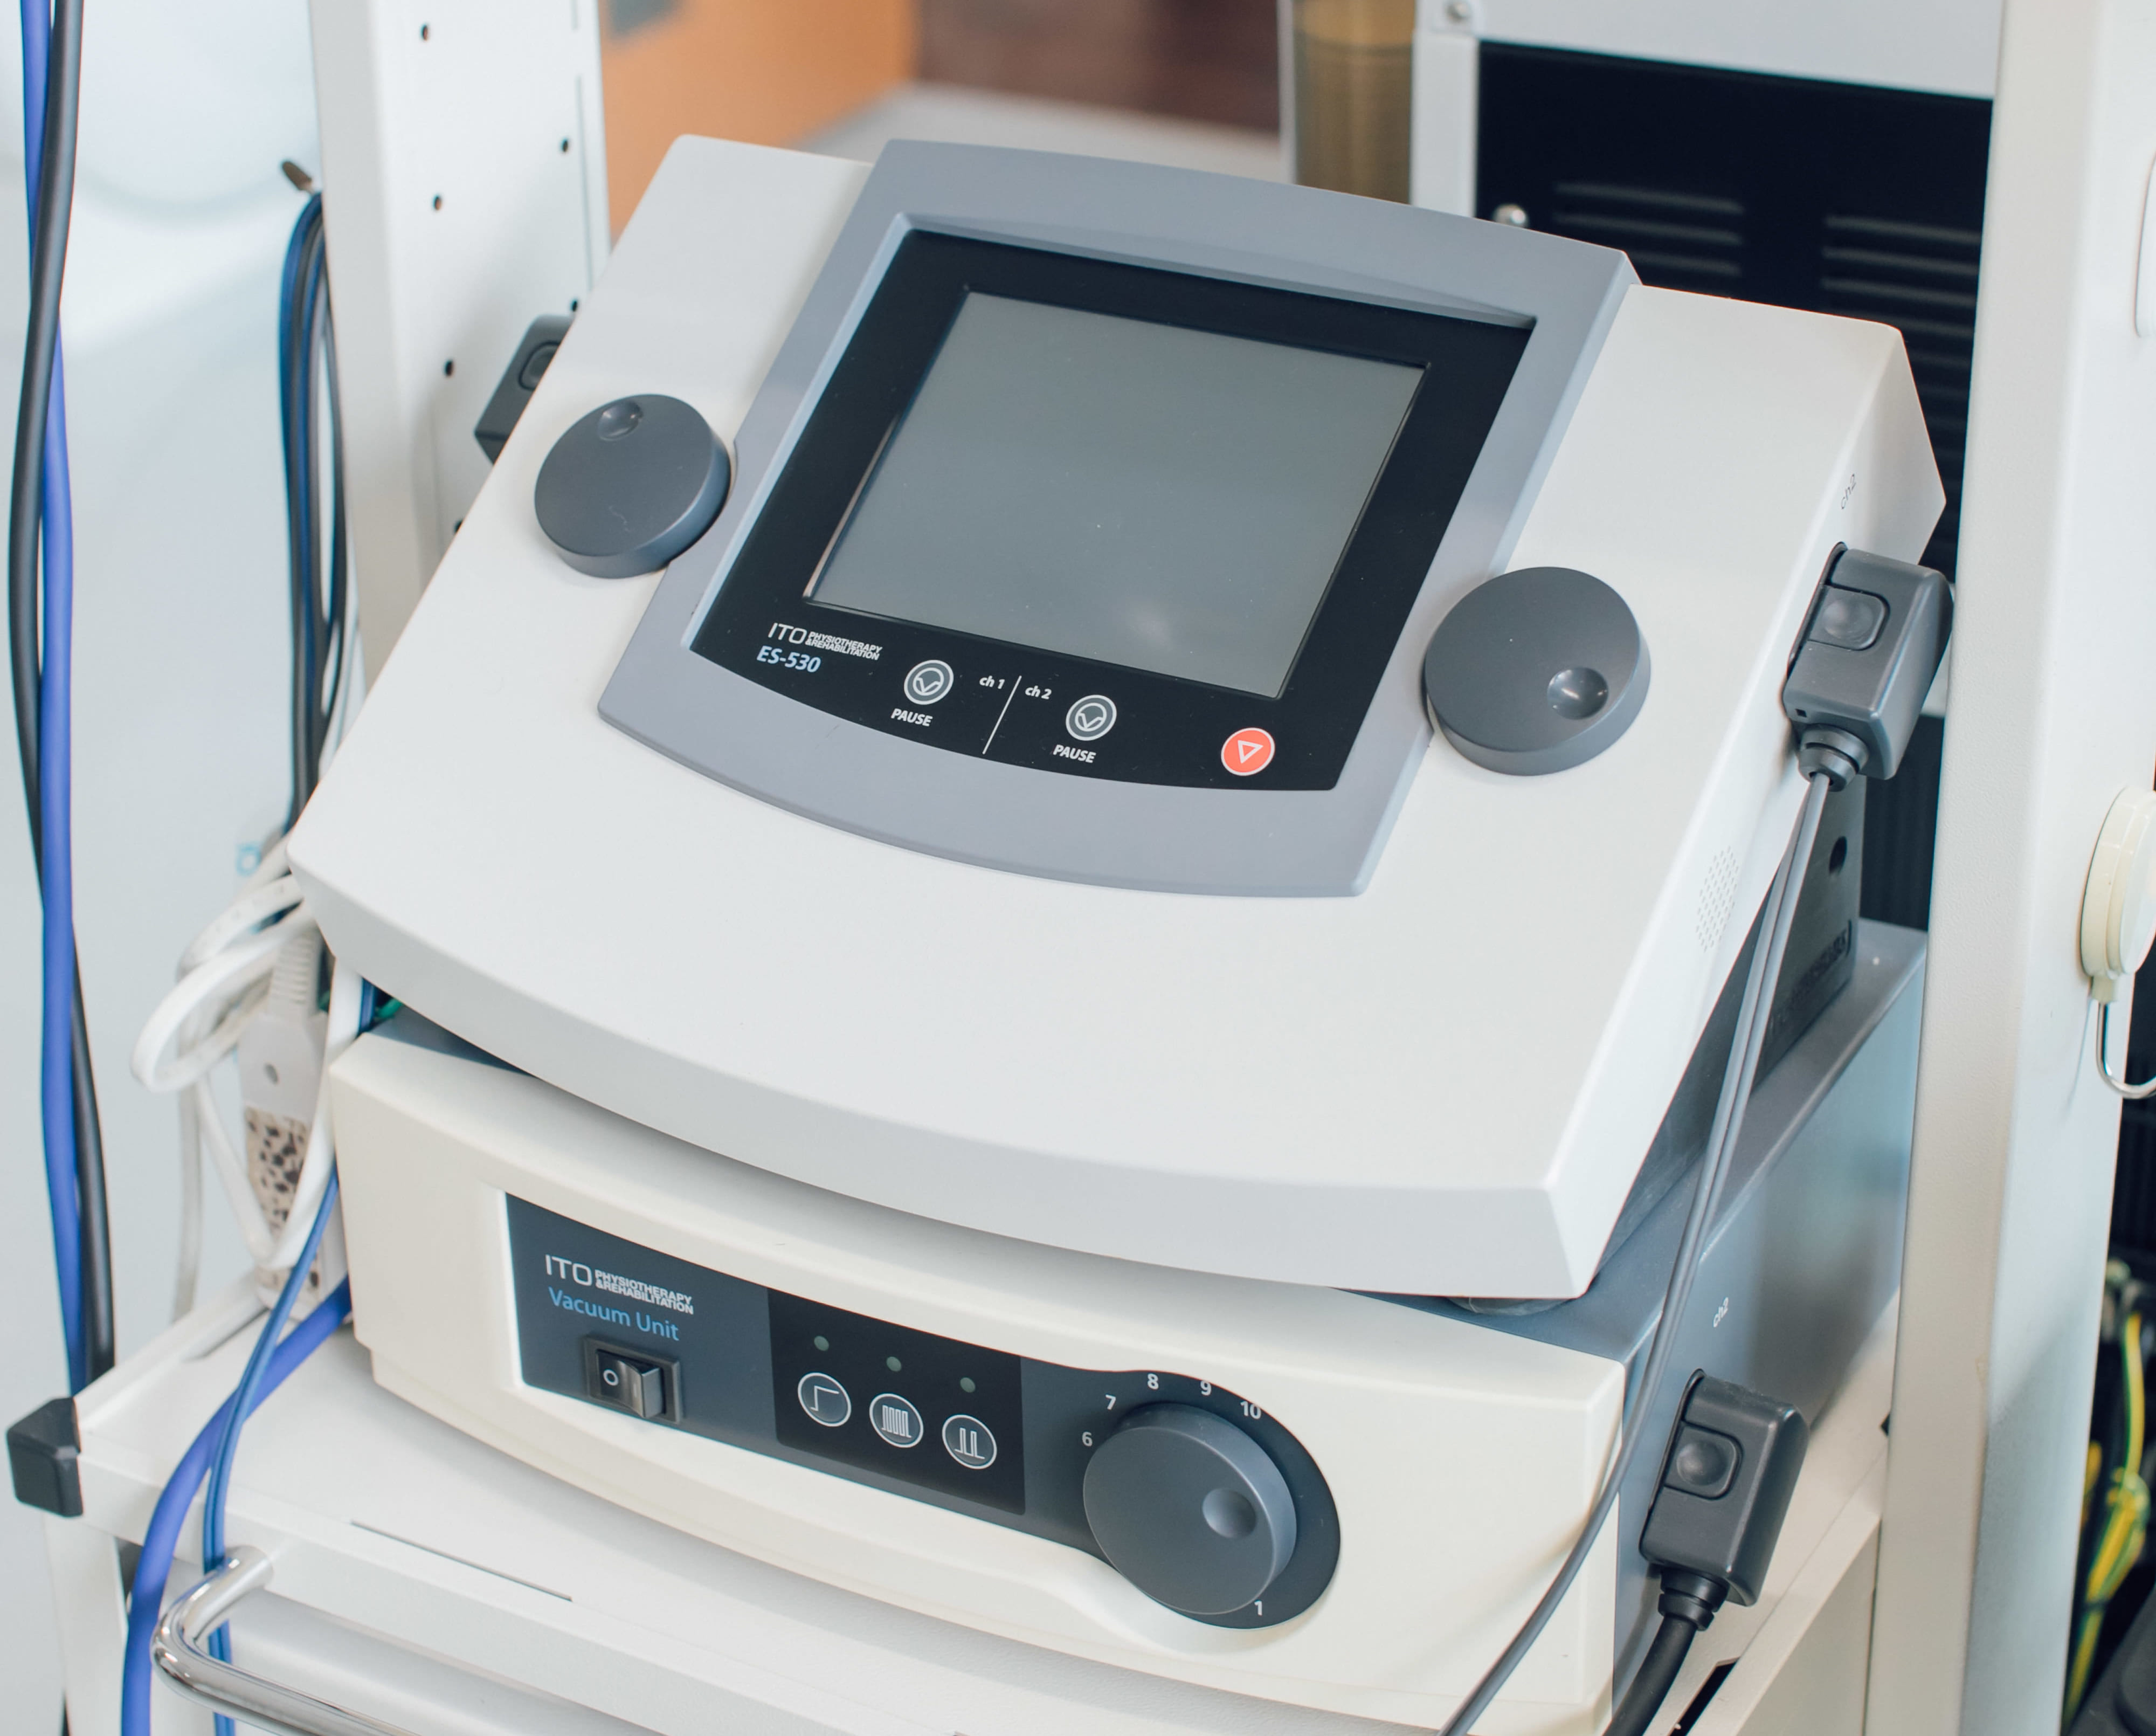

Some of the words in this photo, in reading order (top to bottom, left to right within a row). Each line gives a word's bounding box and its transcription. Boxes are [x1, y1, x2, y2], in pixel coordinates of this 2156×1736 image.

[1841, 473, 1856, 509] ch2
[768, 622, 807, 644] ITO
[808, 631, 883, 653] PHYSIOTHERAPY
[805, 638, 880, 660] &REHABILITATION
[756, 645, 821, 673] ES-530
[979, 675, 995, 688] ch
[997, 678, 1006, 690] 1
[1025, 685, 1041, 697] ch
[1040, 688, 1052, 700] 2
[890, 708, 933, 727] PAUSE
[1052, 744, 1096, 763] PAUSE
[545, 1253, 592, 1286] ITO
[595, 1269, 692, 1305] PHYSIOTHERAPY
[595, 1278, 694, 1315] &REHABILITATION
[548, 1286, 631, 1327] Vacuum
[636, 1312, 680, 1341] Unit
[1713, 1297, 1729, 1328] ch2
[1147, 1373, 1159, 1390] 8
[1200, 1380, 1212, 1396] 9
[1105, 1394, 1116, 1410] 7
[1240, 1400, 1262, 1420] 10
[1081, 1431, 1093, 1447] 6
[1254, 1600, 1263, 1616] 1
